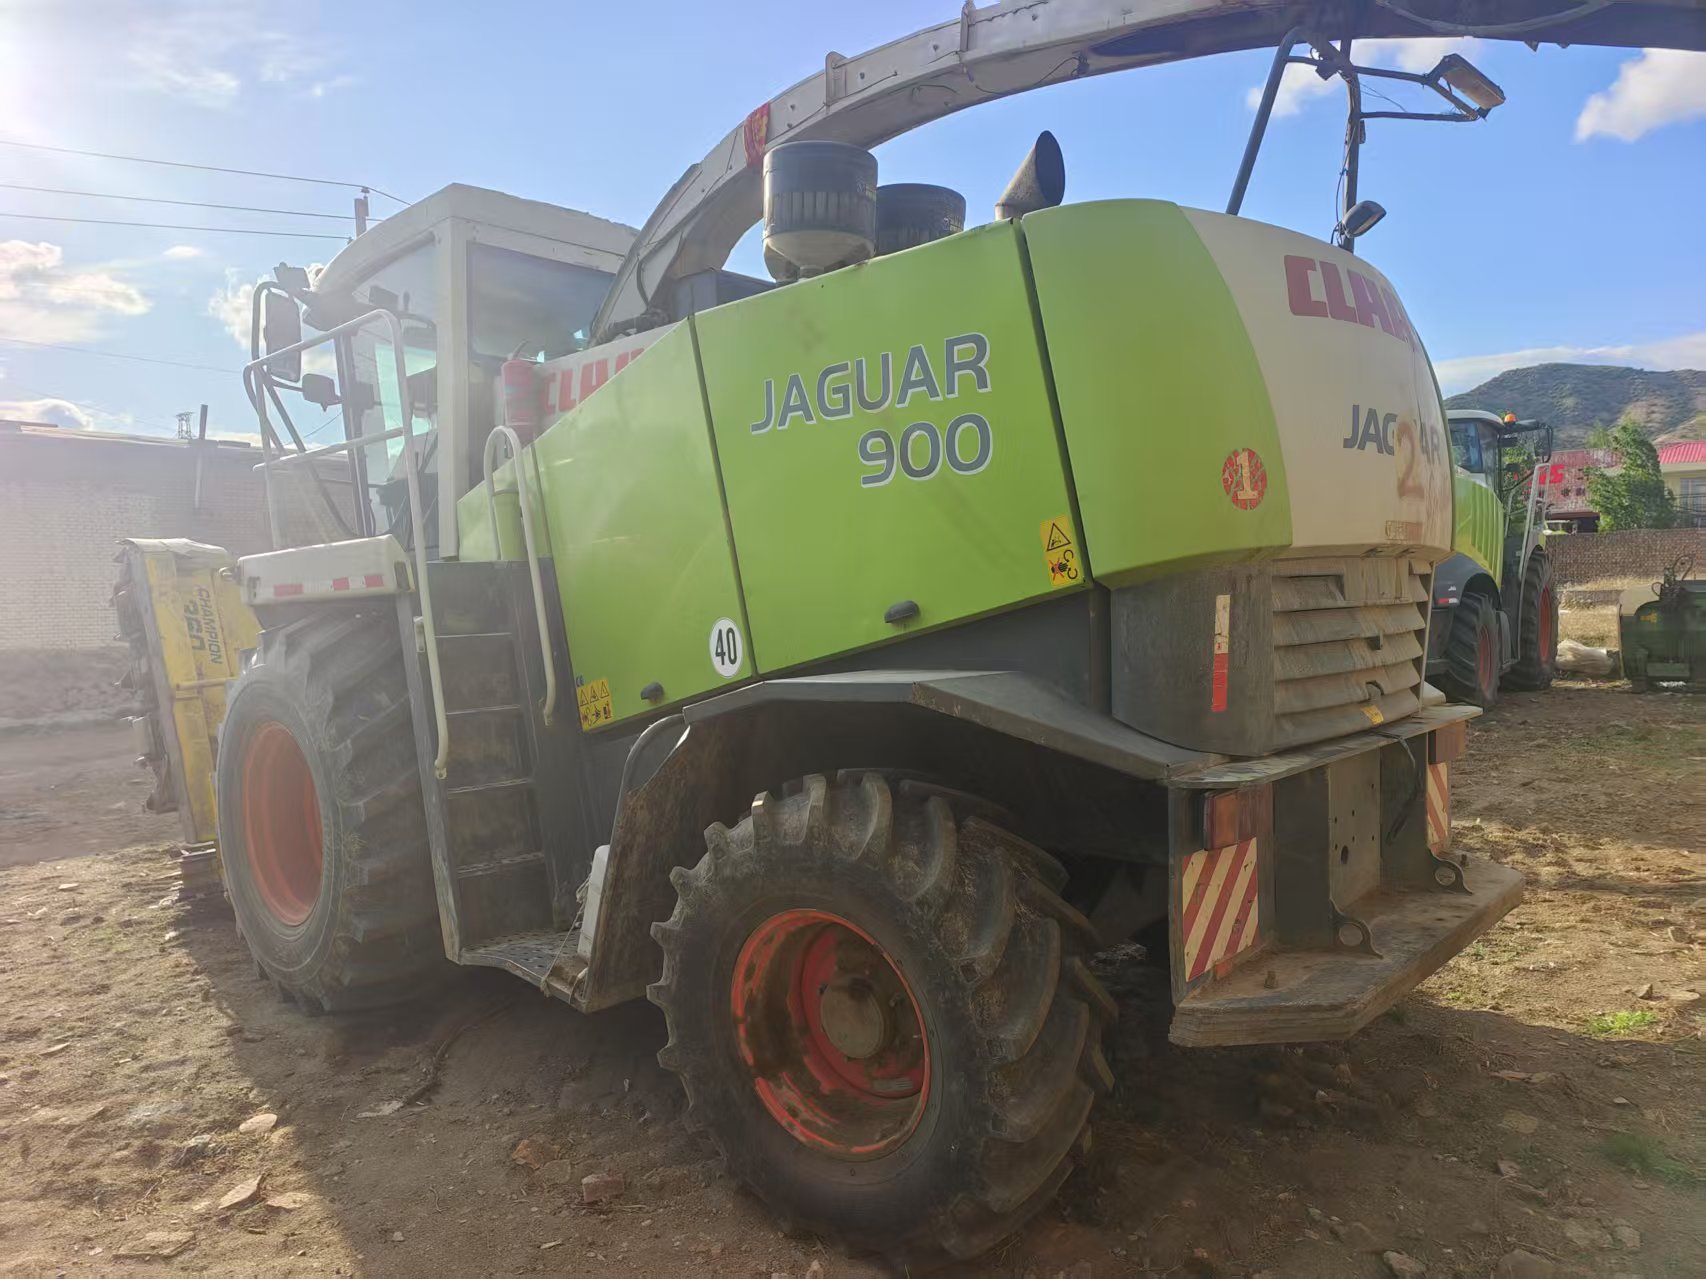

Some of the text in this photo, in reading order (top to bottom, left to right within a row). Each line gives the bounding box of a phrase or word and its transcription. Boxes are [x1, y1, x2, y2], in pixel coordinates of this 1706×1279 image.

[1284, 255, 1415, 347] CLAA
[542, 348, 645, 417] CLA
[751, 332, 992, 435] JAGUAR
[858, 412, 992, 488] 900
[1343, 404, 1441, 466] JAGAR
[198, 587, 223, 664] CHAMPION
[715, 627, 738, 666] 40
